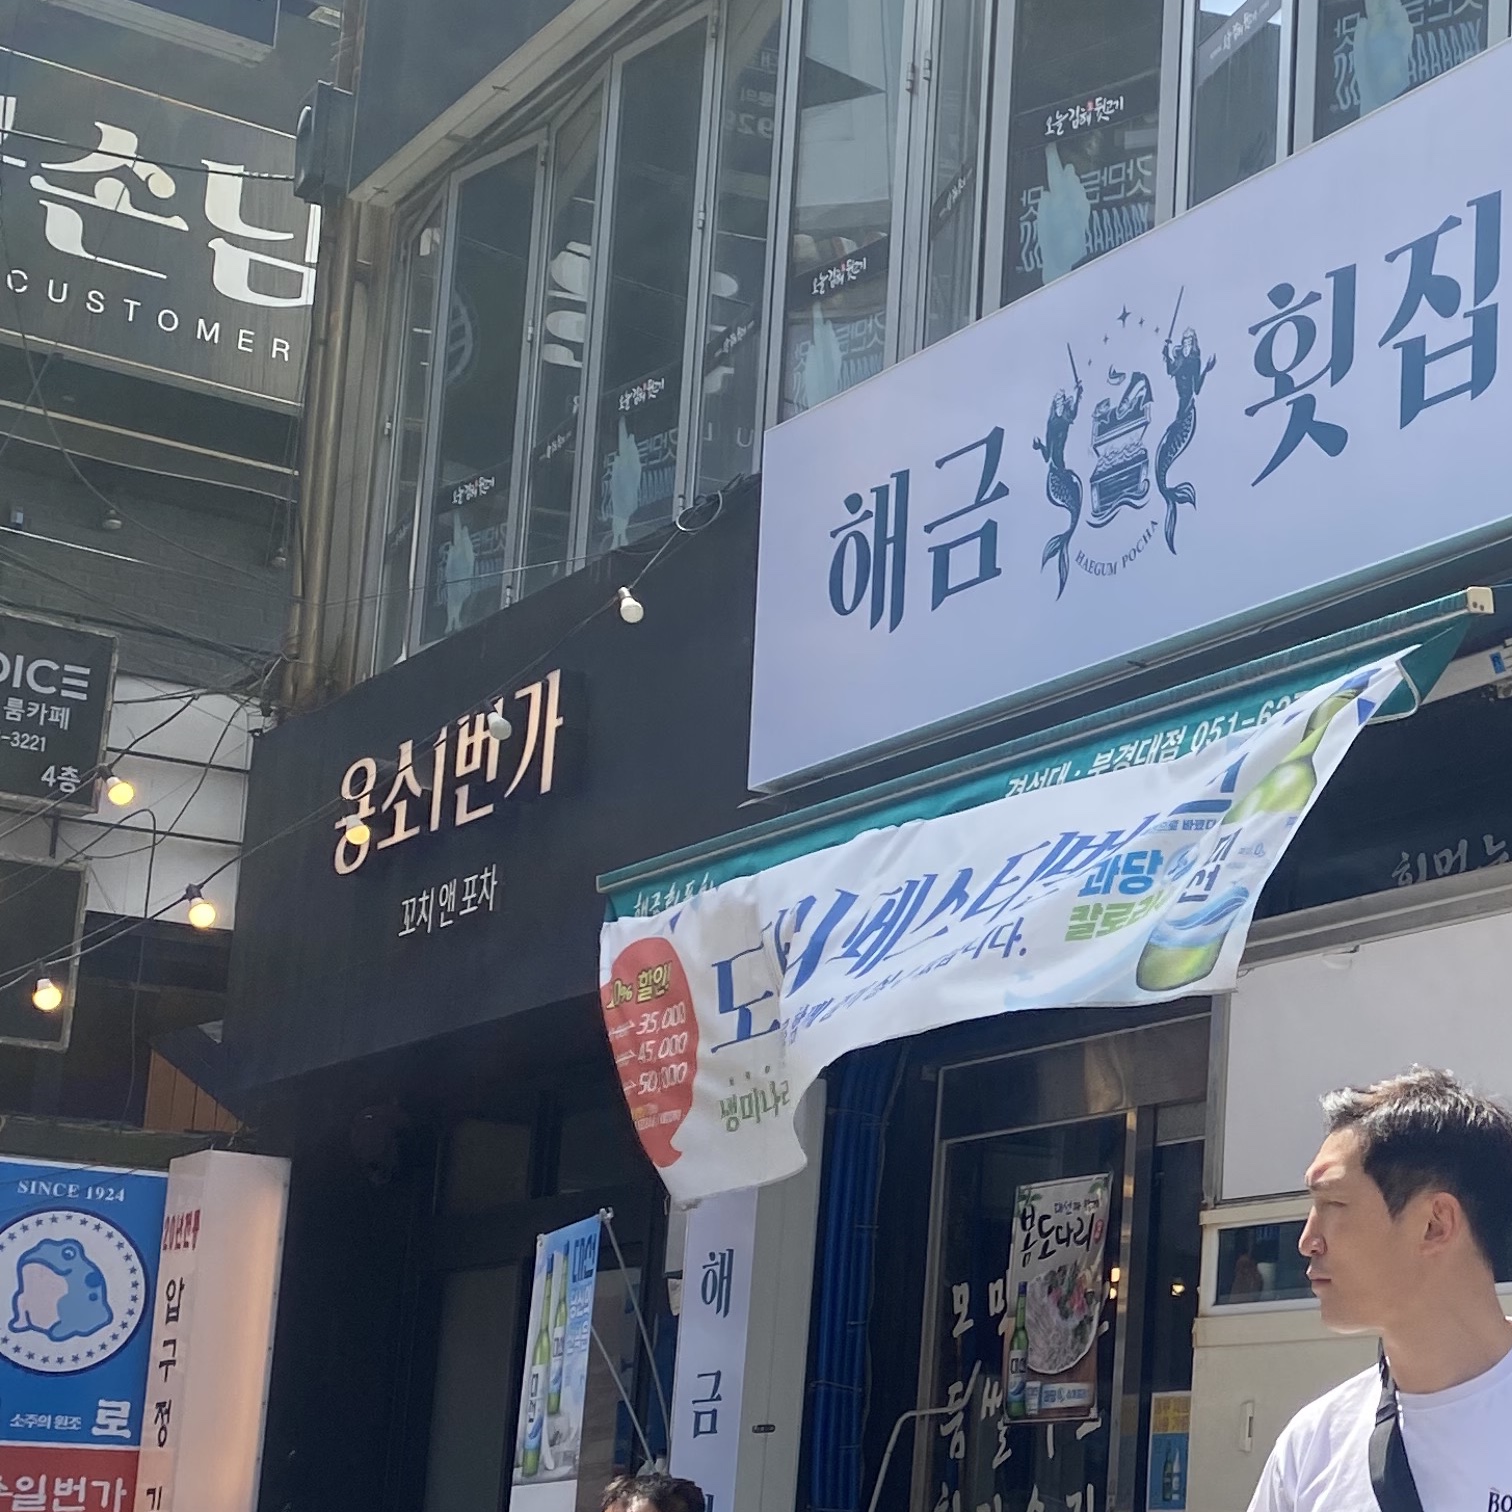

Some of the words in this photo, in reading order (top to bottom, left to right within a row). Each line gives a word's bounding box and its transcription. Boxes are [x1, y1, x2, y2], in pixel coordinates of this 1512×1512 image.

[6, 270, 290, 361] CUSTOMER
[829, 426, 1010, 634] 해금
[1243, 190, 1502, 487] 횟집
[1075, 549, 1118, 576] HAEGUM
[1121, 520, 1158, 568] POCHA
[4, 697, 71, 731] 룸카페
[0, 731, 47, 752] -3221
[41, 765, 81, 793] 4층
[398, 885, 435, 937] 꼬치
[439, 879, 457, 928] 앤
[459, 864, 498, 916] 포차
[17, 1178, 80, 1200] SINCE
[86, 1184, 126, 1203] 1924
[10, 1413, 51, 1430] 소주의
[54, 1414, 82, 1431] 원조
[91, 1399, 132, 1439] 로
